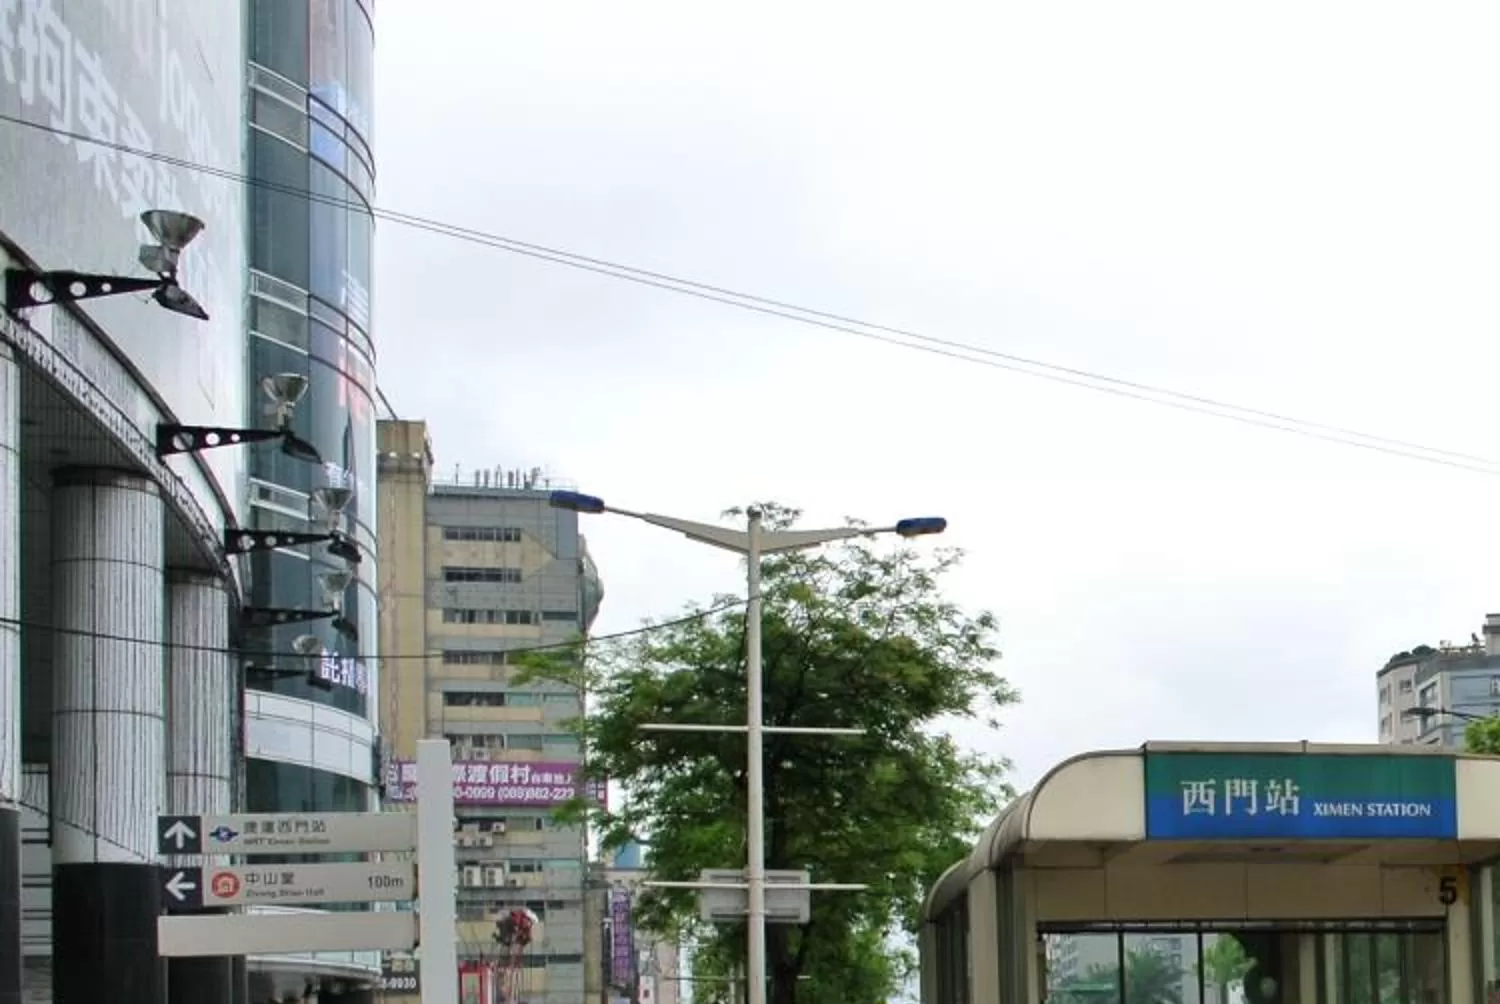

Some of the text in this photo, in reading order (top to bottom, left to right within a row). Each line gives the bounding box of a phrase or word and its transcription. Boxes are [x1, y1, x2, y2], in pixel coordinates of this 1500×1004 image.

[1180, 778, 1300, 816] 西門站
[1313, 802, 1432, 817] XIMEN STATION
[245, 871, 295, 885] 中山堂
[367, 874, 404, 889] 100m
[1438, 876, 1458, 905] 5
